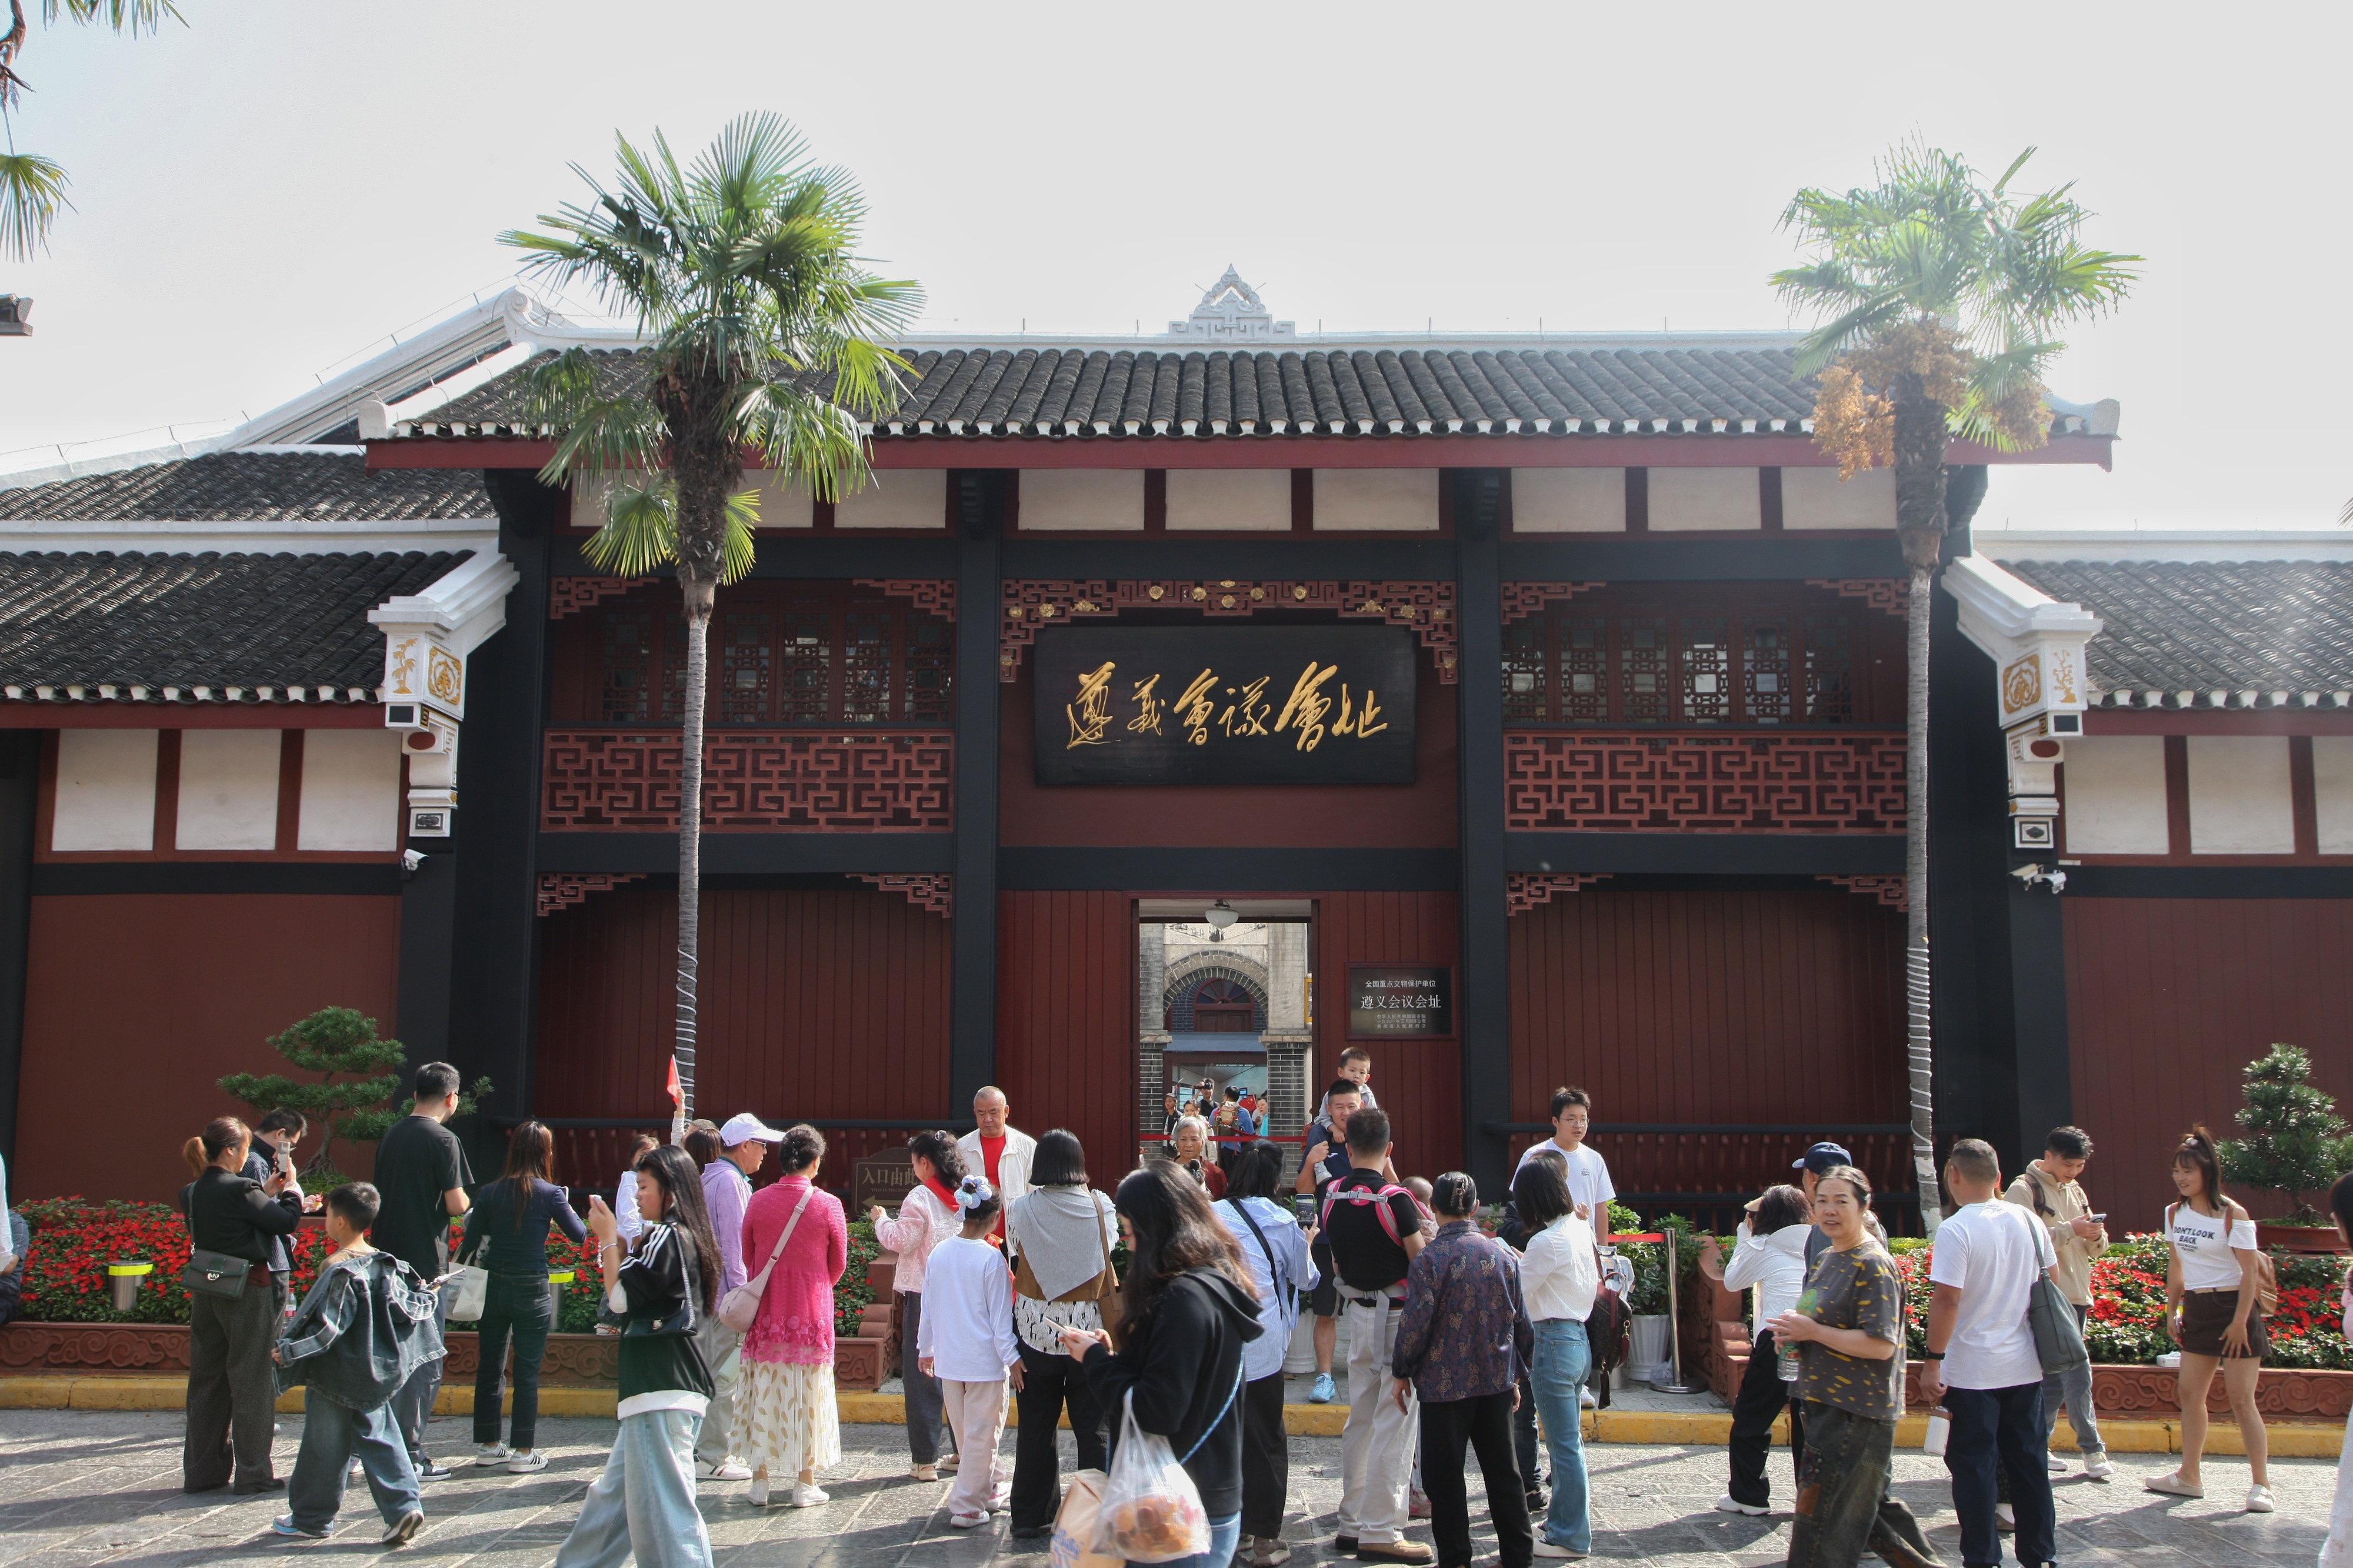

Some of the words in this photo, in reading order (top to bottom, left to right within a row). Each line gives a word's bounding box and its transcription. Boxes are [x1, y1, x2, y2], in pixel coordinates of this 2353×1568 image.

[1365, 980, 1436, 988] 全国重点文物保护单位
[1361, 995, 1441, 1009] 遵义会议会址
[861, 1167, 924, 1186] 入口由此
[2192, 1229, 2215, 1239] LOOK
[2179, 1235, 2197, 1244] BACK
